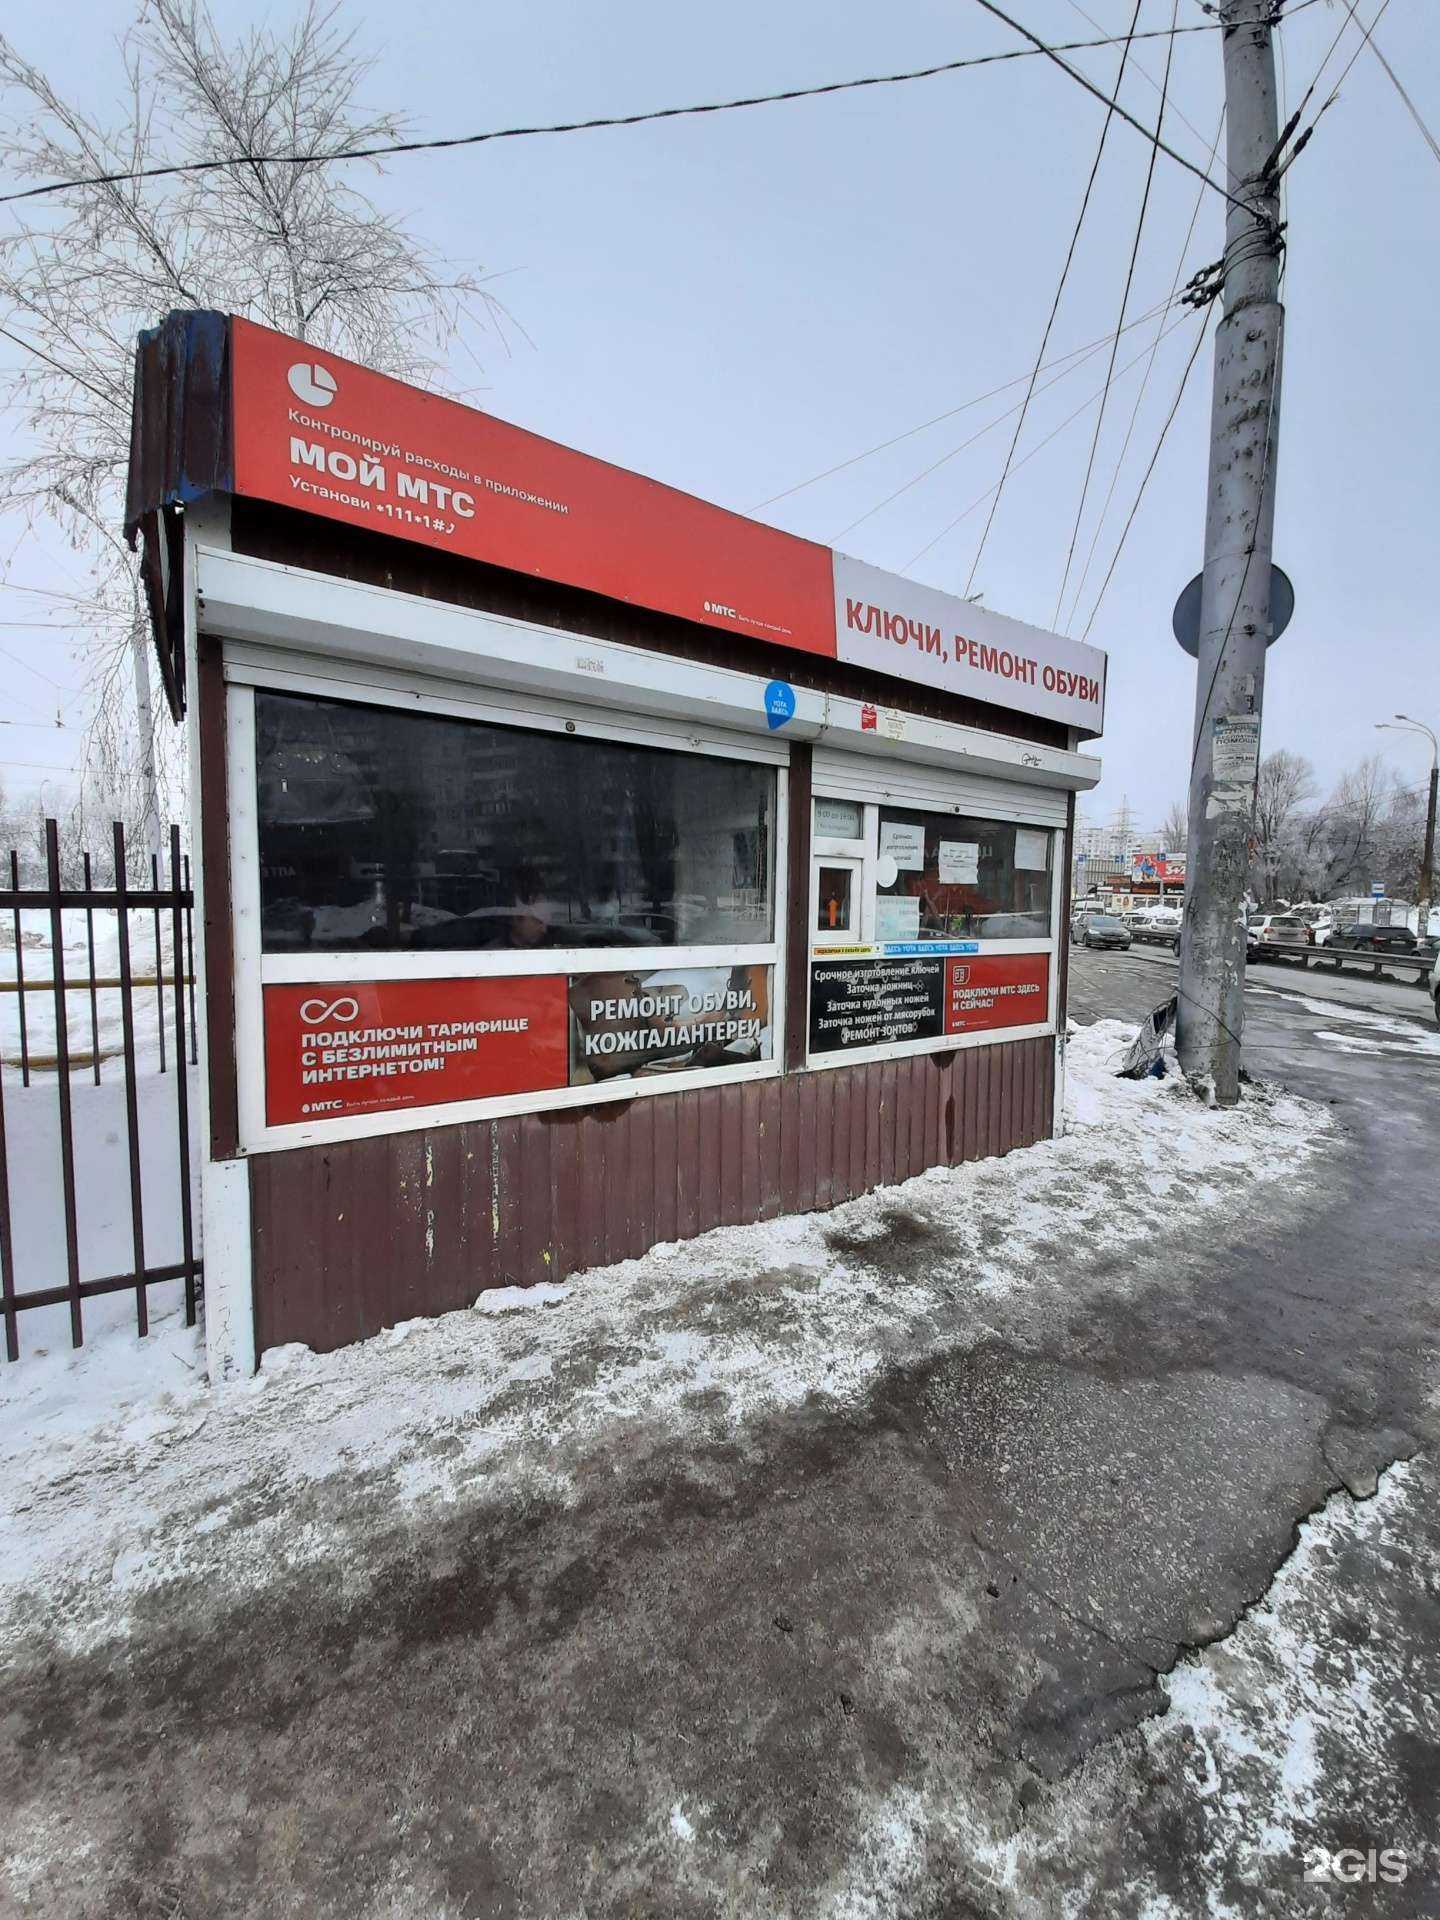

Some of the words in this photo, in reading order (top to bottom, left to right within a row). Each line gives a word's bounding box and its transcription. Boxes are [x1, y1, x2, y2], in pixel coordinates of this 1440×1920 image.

[287, 407, 401, 458] Контролируй
[405, 451, 471, 482] расходы
[473, 473, 482, 485] в
[485, 477, 569, 514] приложении
[290, 436, 386, 492] МОЙ
[397, 472, 477, 519] МТС
[289, 474, 371, 510] Установи
[711, 603, 737, 619] МТС
[846, 598, 949, 663] КЛЮЧИ,
[954, 635, 1038, 686] РЕМОНТ
[1042, 665, 1099, 705] ОБУВИ
[814, 970, 852, 983] Срочное
[854, 967, 911, 979] изготовление
[911, 963, 940, 975] ключей
[846, 983, 880, 994] Заточка
[881, 981, 914, 992] ножниц
[952, 987, 999, 999] ПОДКЛЮЧИ
[1000, 985, 1017, 995] МТС
[1016, 983, 1040, 995] ЗДЕСЬ
[590, 994, 682, 1021] РЕМОНТ
[688, 989, 757, 1014] ОБУВИ,
[826, 1000, 861, 1012] Заточка
[862, 996, 903, 1010] кухонных
[904, 992, 930, 1003] ножей
[952, 1002, 959, 1011] И
[960, 997, 994, 1010] СЕЙЧАС!
[818, 1018, 853, 1029] Заточка
[854, 1011, 882, 1024] ножей
[883, 1012, 893, 1021] от
[893, 1007, 936, 1020] мясорубок
[301, 1025, 423, 1048] ПОДКЛЮЧИ
[427, 1018, 529, 1037] ТАРИФИЩЕ
[845, 1027, 880, 1041] РЕМОНТ
[881, 1023, 914, 1037] ЗОНТОВ
[302, 1051, 317, 1066] С
[322, 1038, 478, 1064] БЕЗЛИМИТНЫМ
[302, 1056, 445, 1085] ИНТЕРНЕТОМ!
[311, 1099, 344, 1112] МТС
